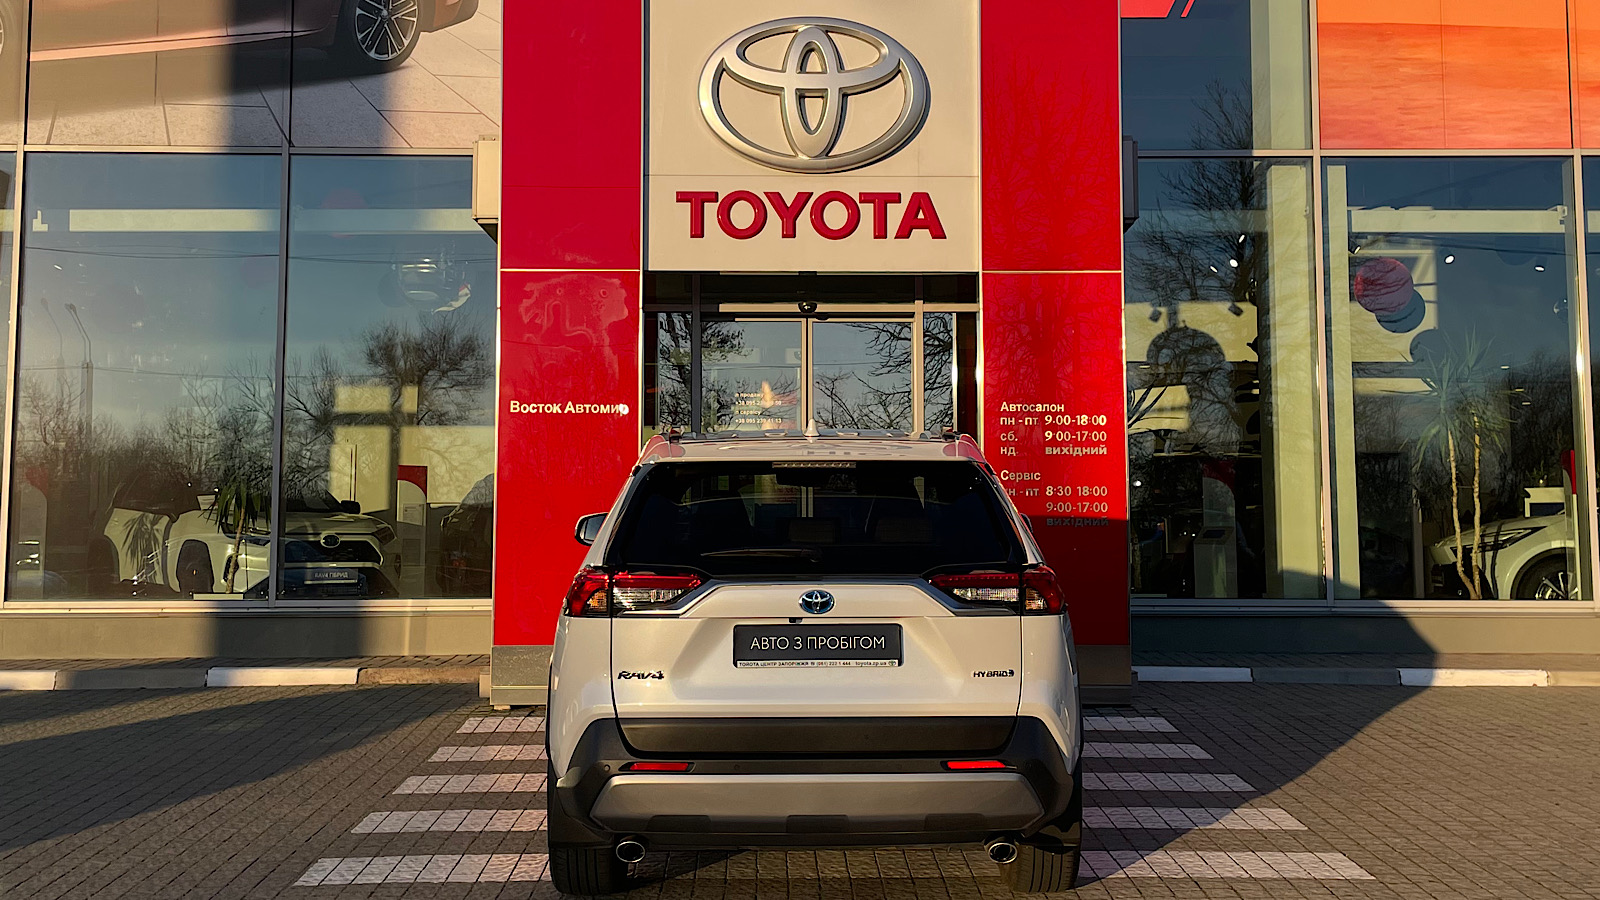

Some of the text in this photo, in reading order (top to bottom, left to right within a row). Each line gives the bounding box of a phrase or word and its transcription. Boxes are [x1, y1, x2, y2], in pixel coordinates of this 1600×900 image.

[676, 190, 946, 240] TOYOTA
[510, 400, 562, 413] Восток
[1000, 402, 1065, 412] Автосалон
[1000, 431, 1018, 441] сб.
[1045, 444, 1107, 456] вихідний
[1000, 470, 1041, 482] Сервіс
[1046, 502, 1108, 512] 9:00-17:00
[1046, 515, 1109, 527] вихідний
[750, 636, 885, 650] АВТО З ПРОБІГОМ
[617, 670, 664, 680] RAV4
